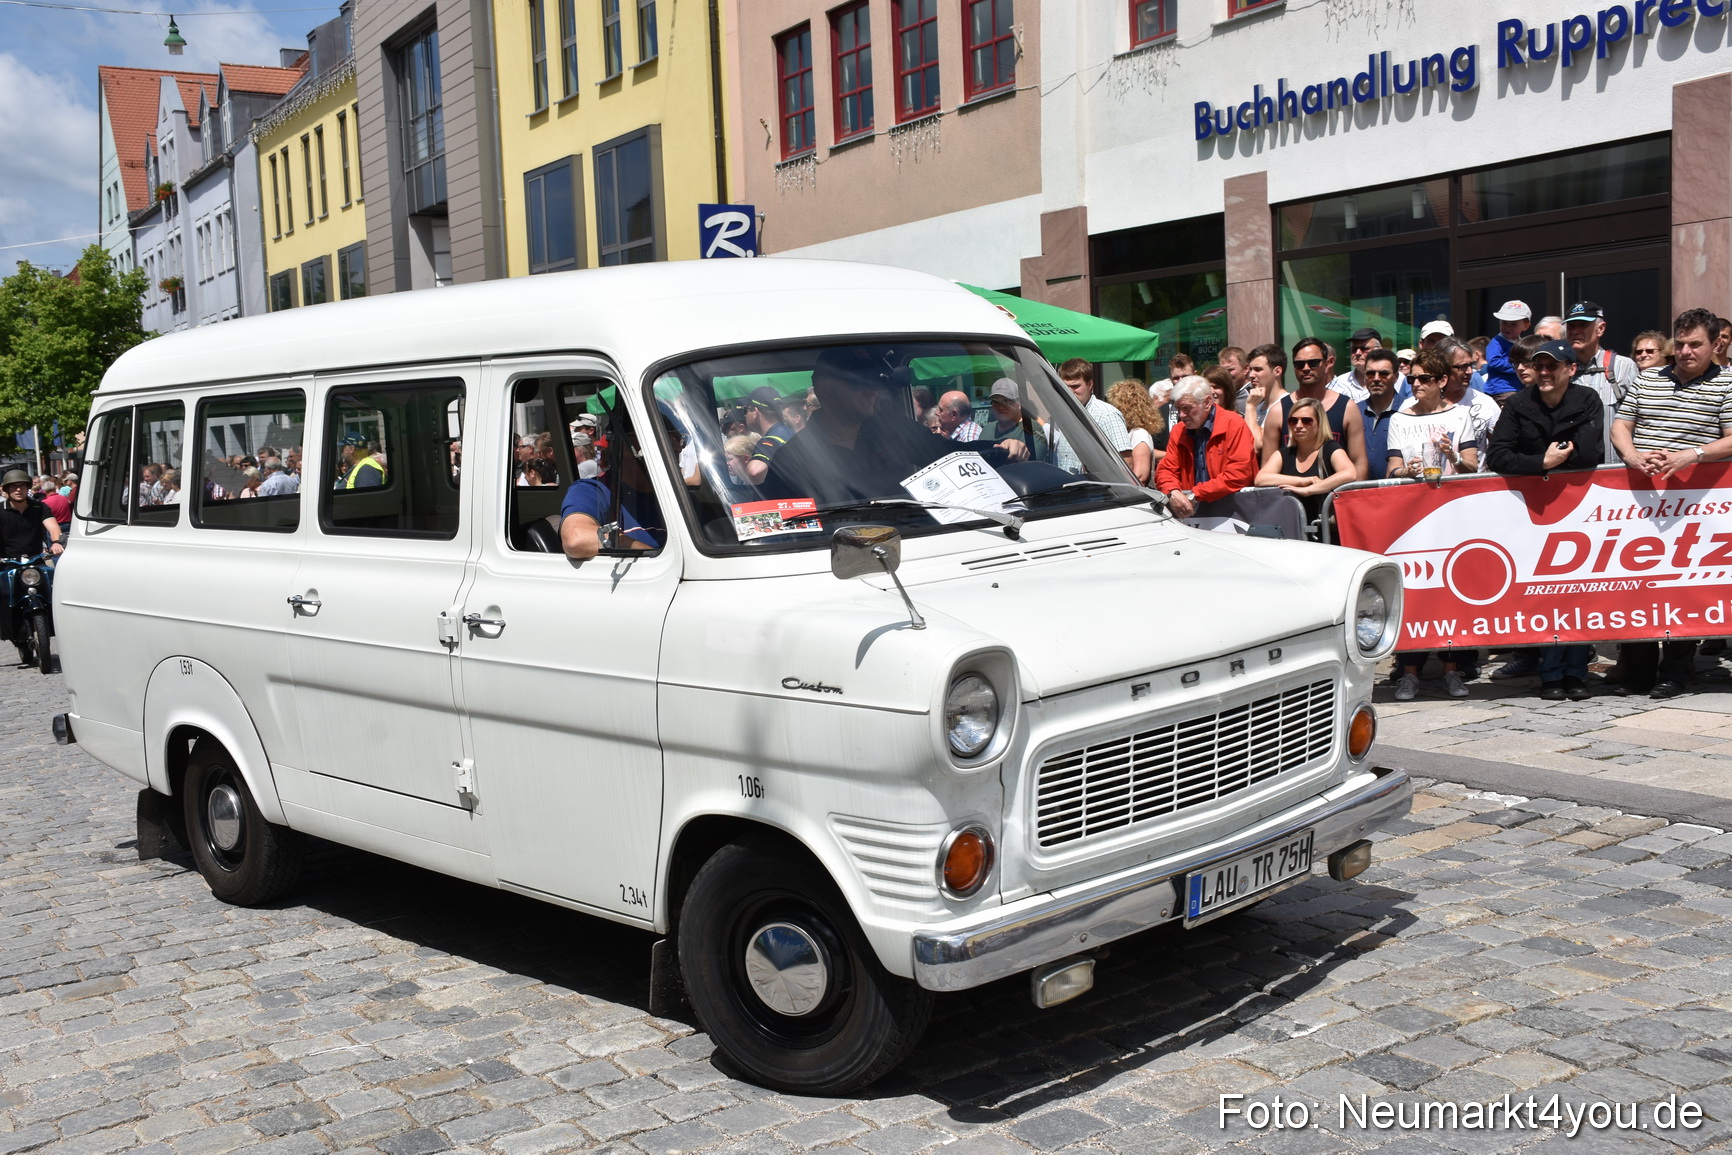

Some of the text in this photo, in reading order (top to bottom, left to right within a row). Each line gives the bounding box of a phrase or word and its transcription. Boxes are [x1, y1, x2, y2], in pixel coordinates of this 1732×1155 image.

[1194, 0, 1732, 141] Buchhandlung Ruppre
[1194, 337, 1220, 346] GARTEN
[1198, 346, 1217, 354] BUCH
[958, 462, 987, 478] 492
[1584, 497, 1732, 524] Autoklass
[1532, 523, 1732, 577] Dietz
[1524, 580, 1643, 596] BREITENBRUNN
[781, 677, 843, 694] Custom
[1131, 648, 1282, 701] FORD
[738, 774, 765, 799] 1,06t
[1201, 866, 1238, 909] LAU
[1252, 851, 1274, 888] TR
[1278, 836, 1311, 880] 75H
[619, 884, 648, 908] 2,34t
